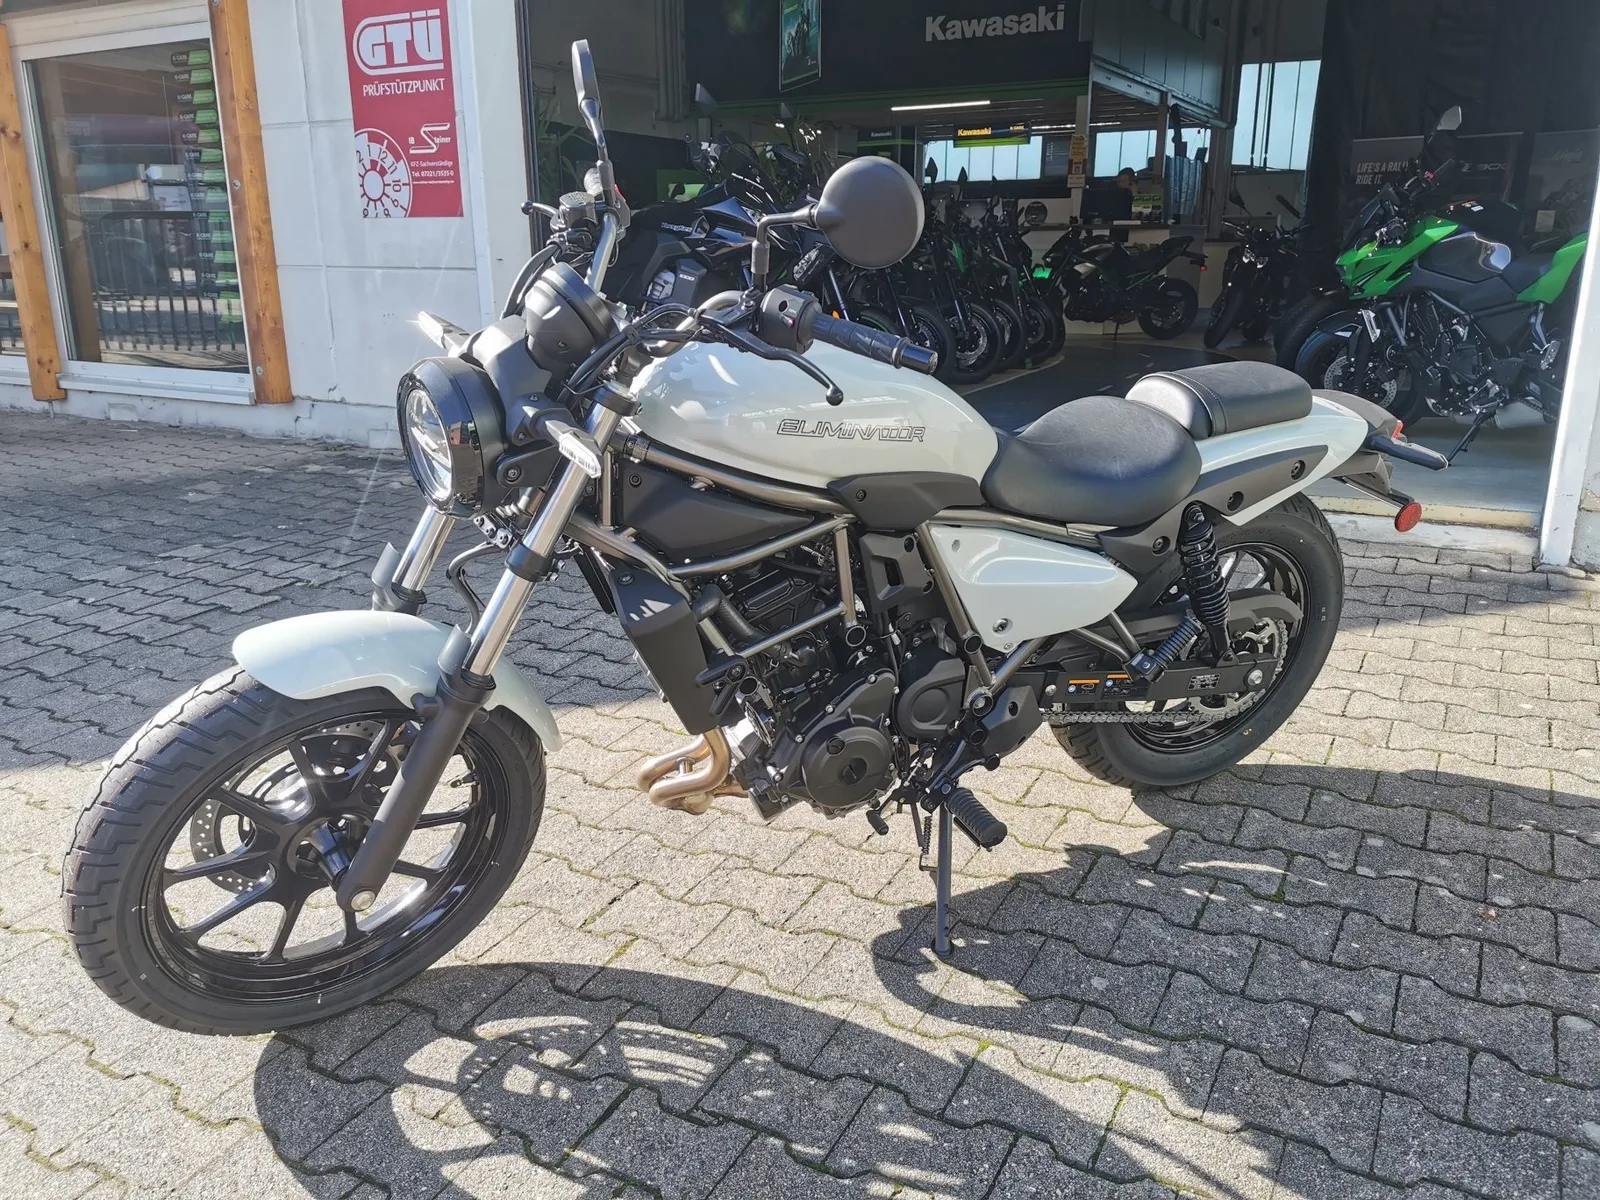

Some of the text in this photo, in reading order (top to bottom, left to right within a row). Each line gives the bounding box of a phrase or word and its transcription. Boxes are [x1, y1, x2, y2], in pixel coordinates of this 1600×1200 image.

[926, 4, 1064, 42] Kawasaki
[357, 9, 444, 67] GTÜ
[362, 77, 445, 97] PRÜFSTÜTZPUNKT
[957, 126, 992, 136] Kawasaki
[378, 147, 388, 164] 12
[1356, 161, 1381, 173] LIFE'S
[1380, 161, 1386, 172] A
[392, 178, 402, 193] 10
[1355, 174, 1374, 185] RIDE
[776, 418, 926, 443] ELIMINATOR
